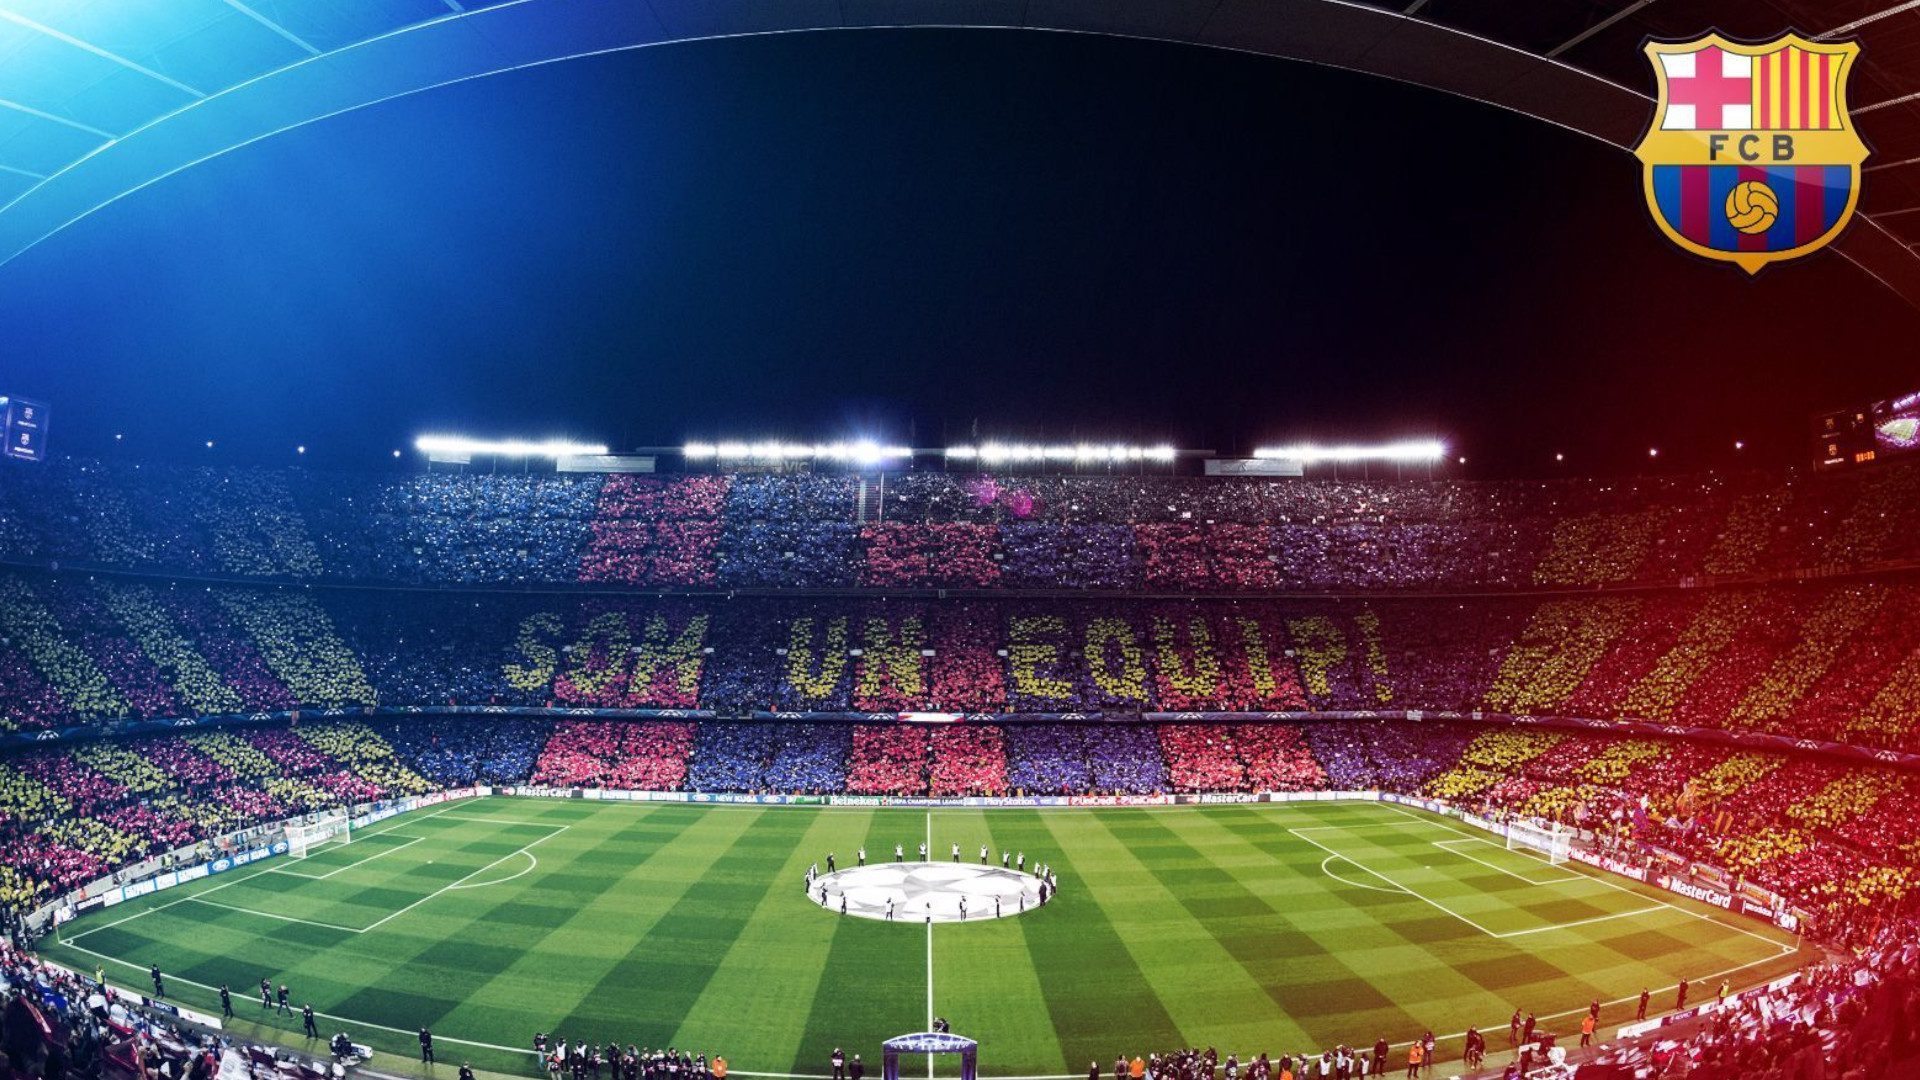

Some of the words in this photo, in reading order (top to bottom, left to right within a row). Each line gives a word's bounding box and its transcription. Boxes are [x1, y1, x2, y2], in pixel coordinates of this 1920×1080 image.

[502, 612, 709, 695] SOM
[786, 615, 923, 698] UN
[1009, 610, 1393, 701] EQUIP!
[516, 786, 572, 798] MasterCard
[830, 796, 880, 806] Heineken
[985, 797, 1035, 806] PlayStation
[1201, 793, 1258, 804] MasterCard
[233, 852, 249, 866] NEW
[1670, 876, 1732, 909] MasterCard
